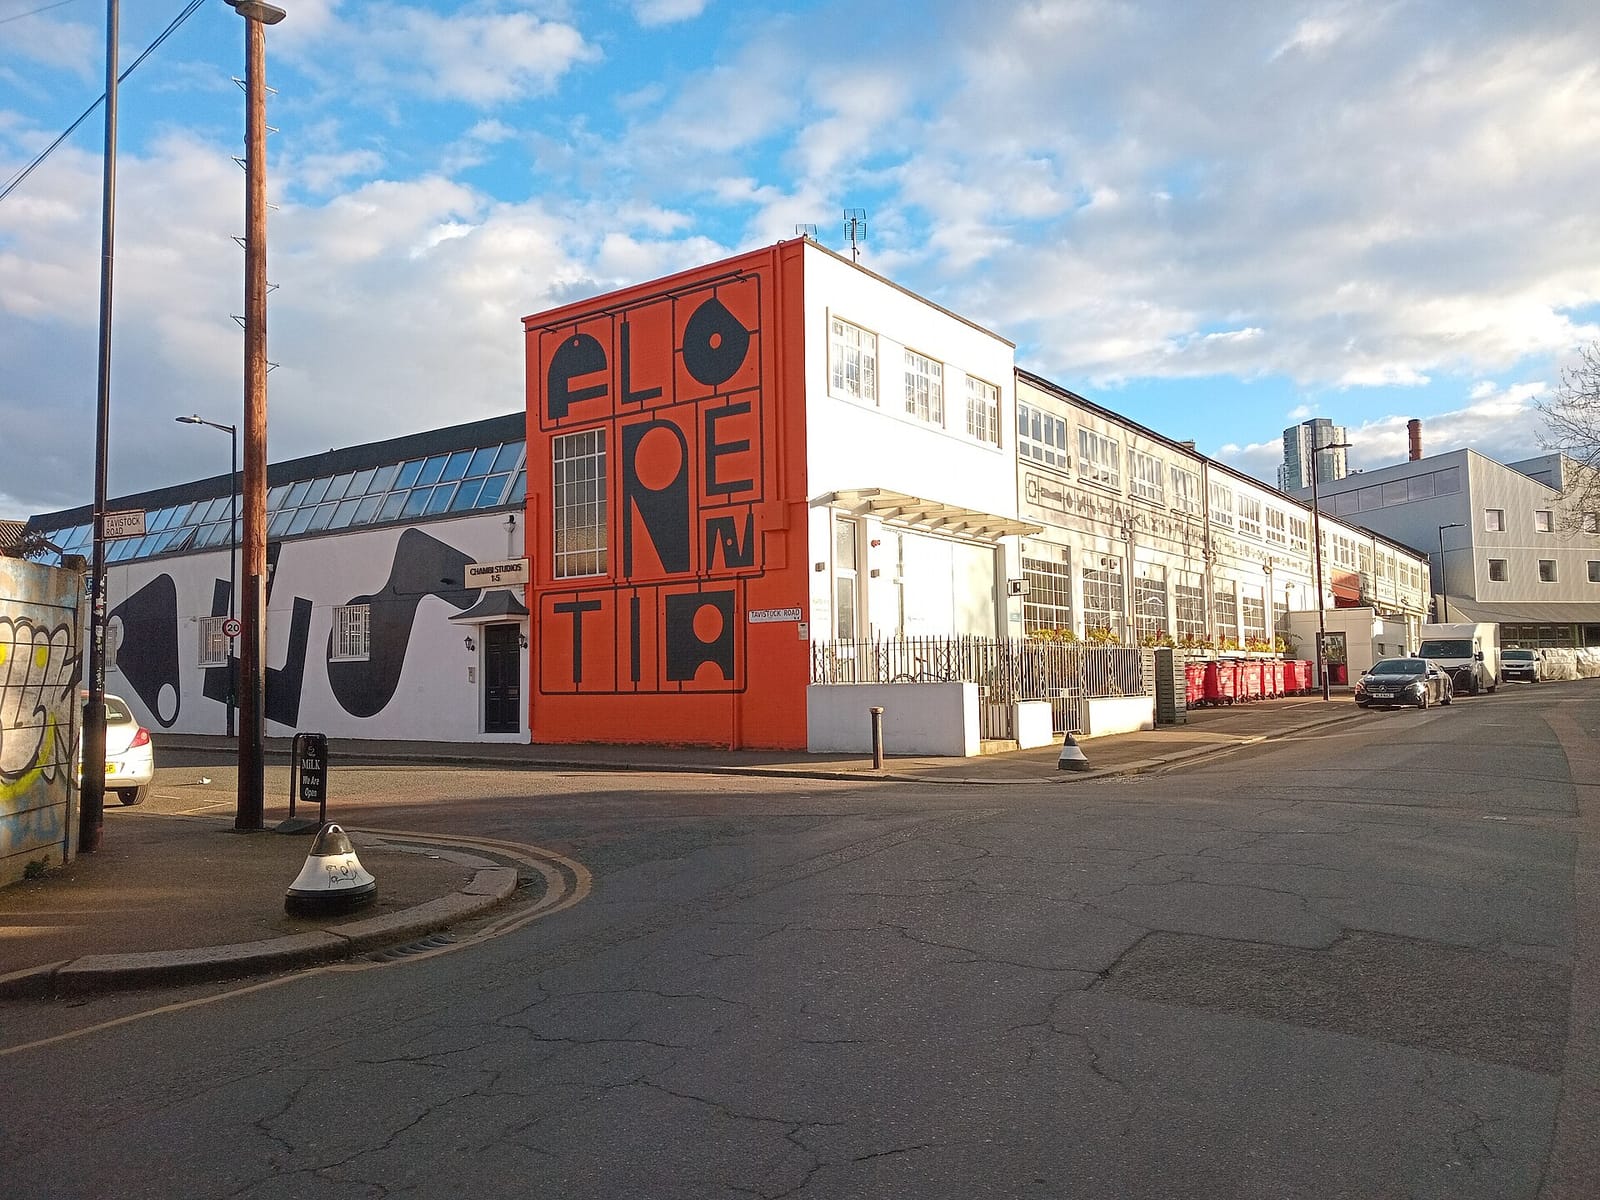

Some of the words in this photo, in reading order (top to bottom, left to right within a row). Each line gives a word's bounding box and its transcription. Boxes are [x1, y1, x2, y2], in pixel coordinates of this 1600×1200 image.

[106, 517, 140, 527] TAVISTOCK
[105, 527, 123, 536] ROAD
[495, 563, 522, 574] STUDIOS
[751, 610, 782, 618] TAVISTOCK
[783, 608, 800, 617] ROAD
[227, 623, 240, 632] 20
[302, 775, 310, 785] We
[310, 775, 320, 786] Are
[304, 787, 317, 799] Open
